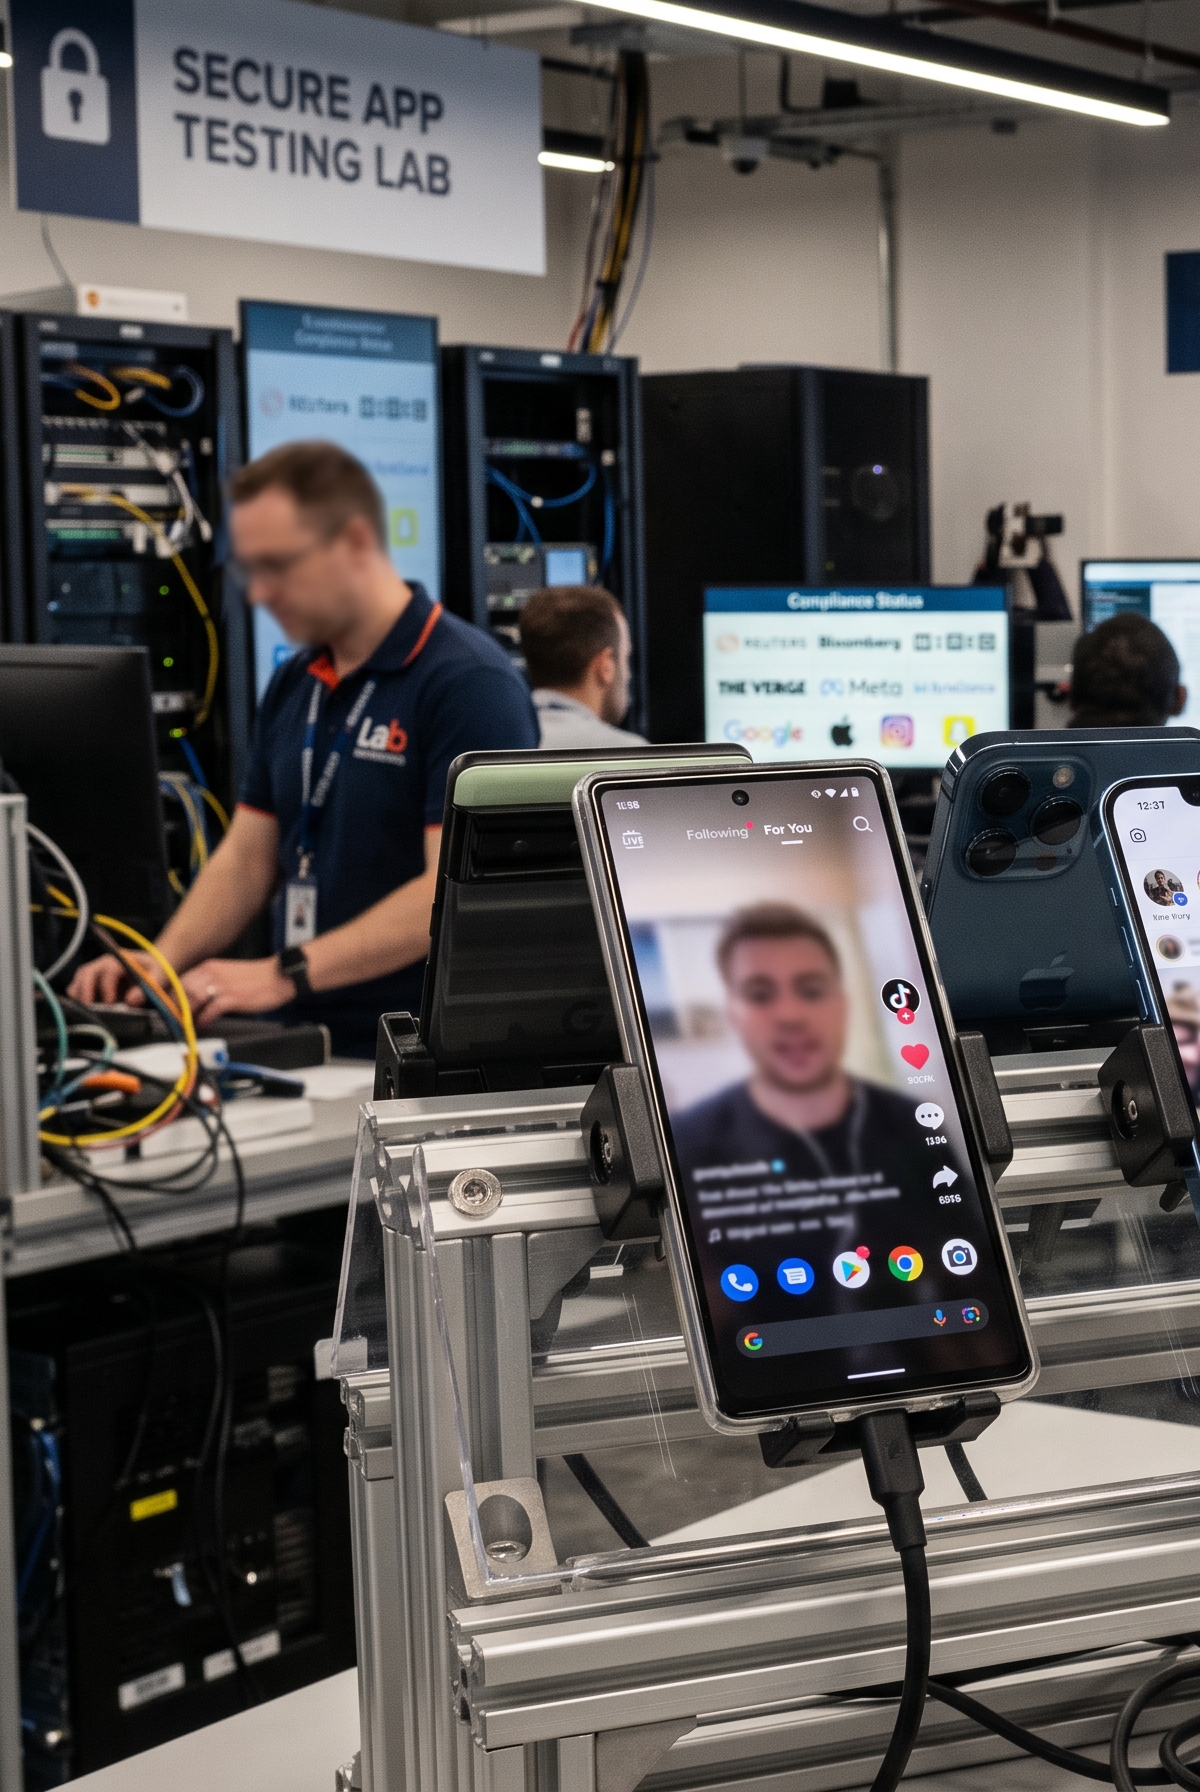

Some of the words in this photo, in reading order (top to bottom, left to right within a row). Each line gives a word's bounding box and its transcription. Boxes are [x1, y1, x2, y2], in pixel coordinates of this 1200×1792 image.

[173, 46, 350, 121] SECURE
[362, 82, 445, 134] APP
[174, 113, 362, 183] TESTING
[375, 145, 451, 197] LAB
[786, 591, 874, 611] Compliance
[875, 591, 925, 610] Status
[818, 635, 902, 651] Bloomberg
[718, 680, 746, 695] THE
[751, 679, 806, 695] VERGE
[848, 678, 903, 697] Meta
[355, 716, 409, 754] Lab
[723, 718, 804, 748] Google
[1137, 800, 1166, 811] 12:37
[686, 826, 749, 841] Following
[763, 823, 785, 836] For
[787, 821, 813, 835] You
[622, 836, 644, 846] LIVE
